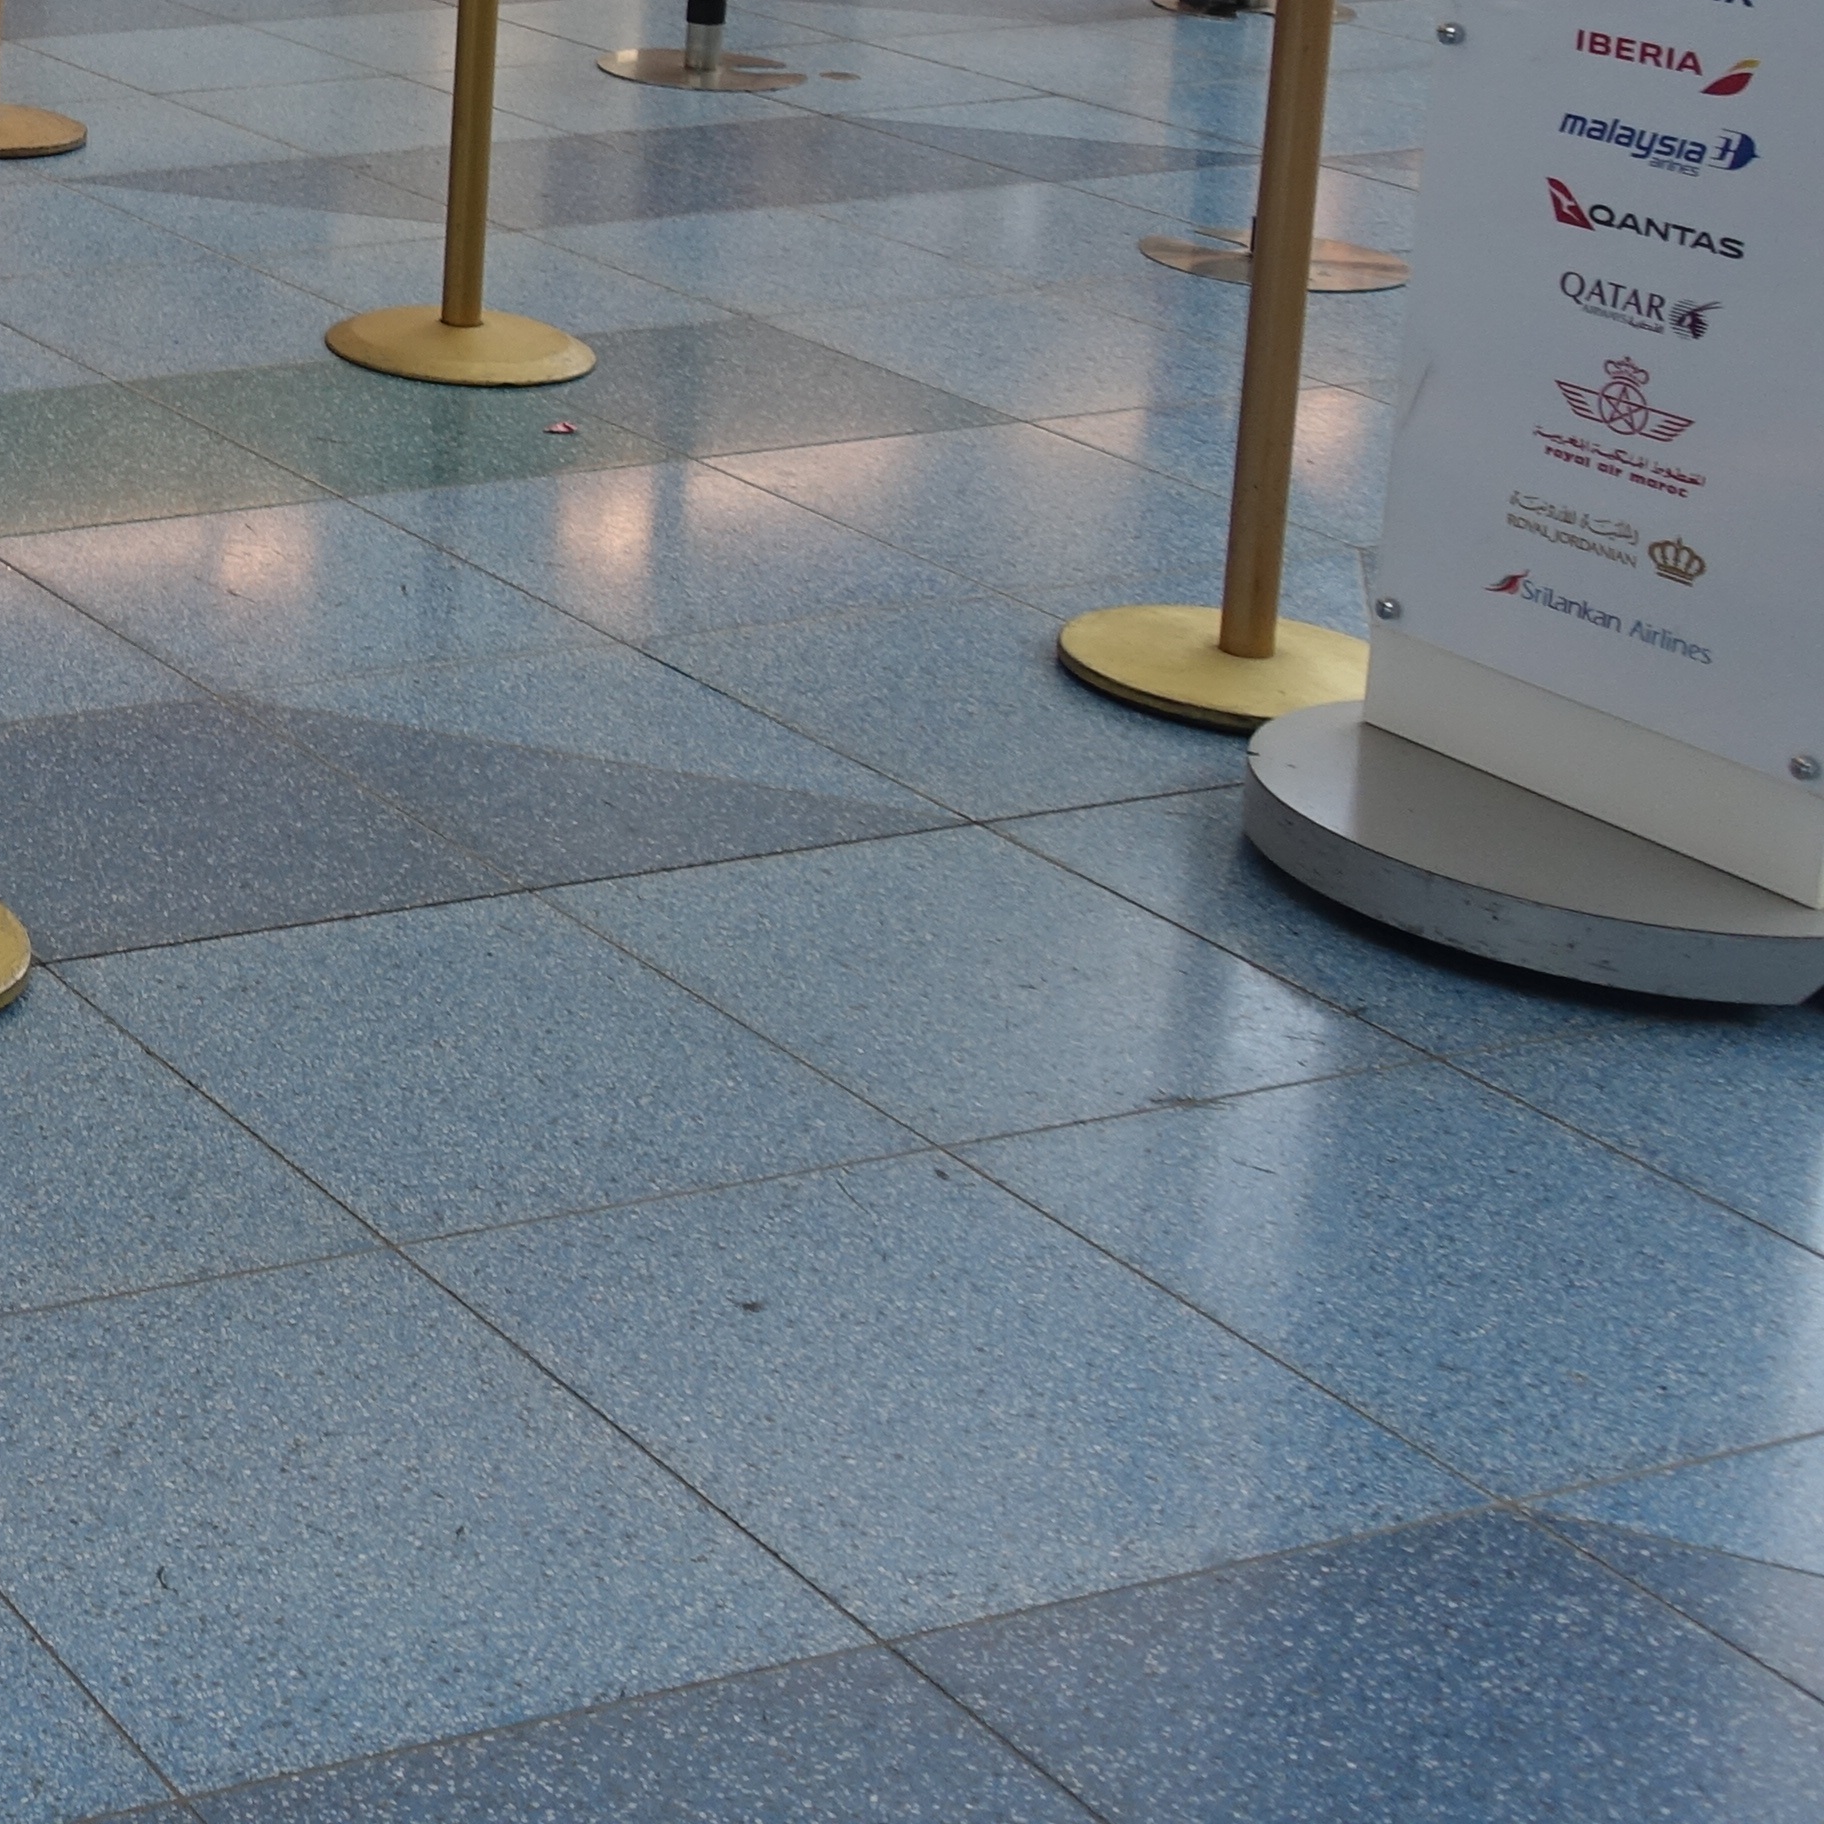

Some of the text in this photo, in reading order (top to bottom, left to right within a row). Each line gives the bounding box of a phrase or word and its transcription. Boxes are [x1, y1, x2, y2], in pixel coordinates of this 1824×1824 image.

[1575, 29, 1703, 77] IBERIA
[1558, 112, 1707, 164] malaysia
[1588, 203, 1746, 261] QANTAS
[1559, 271, 1666, 323] QATAR
[1544, 444, 1689, 500] royal air maroc
[1507, 513, 1553, 542] ROYAL
[1521, 579, 1713, 666] SriLankan Airlines
